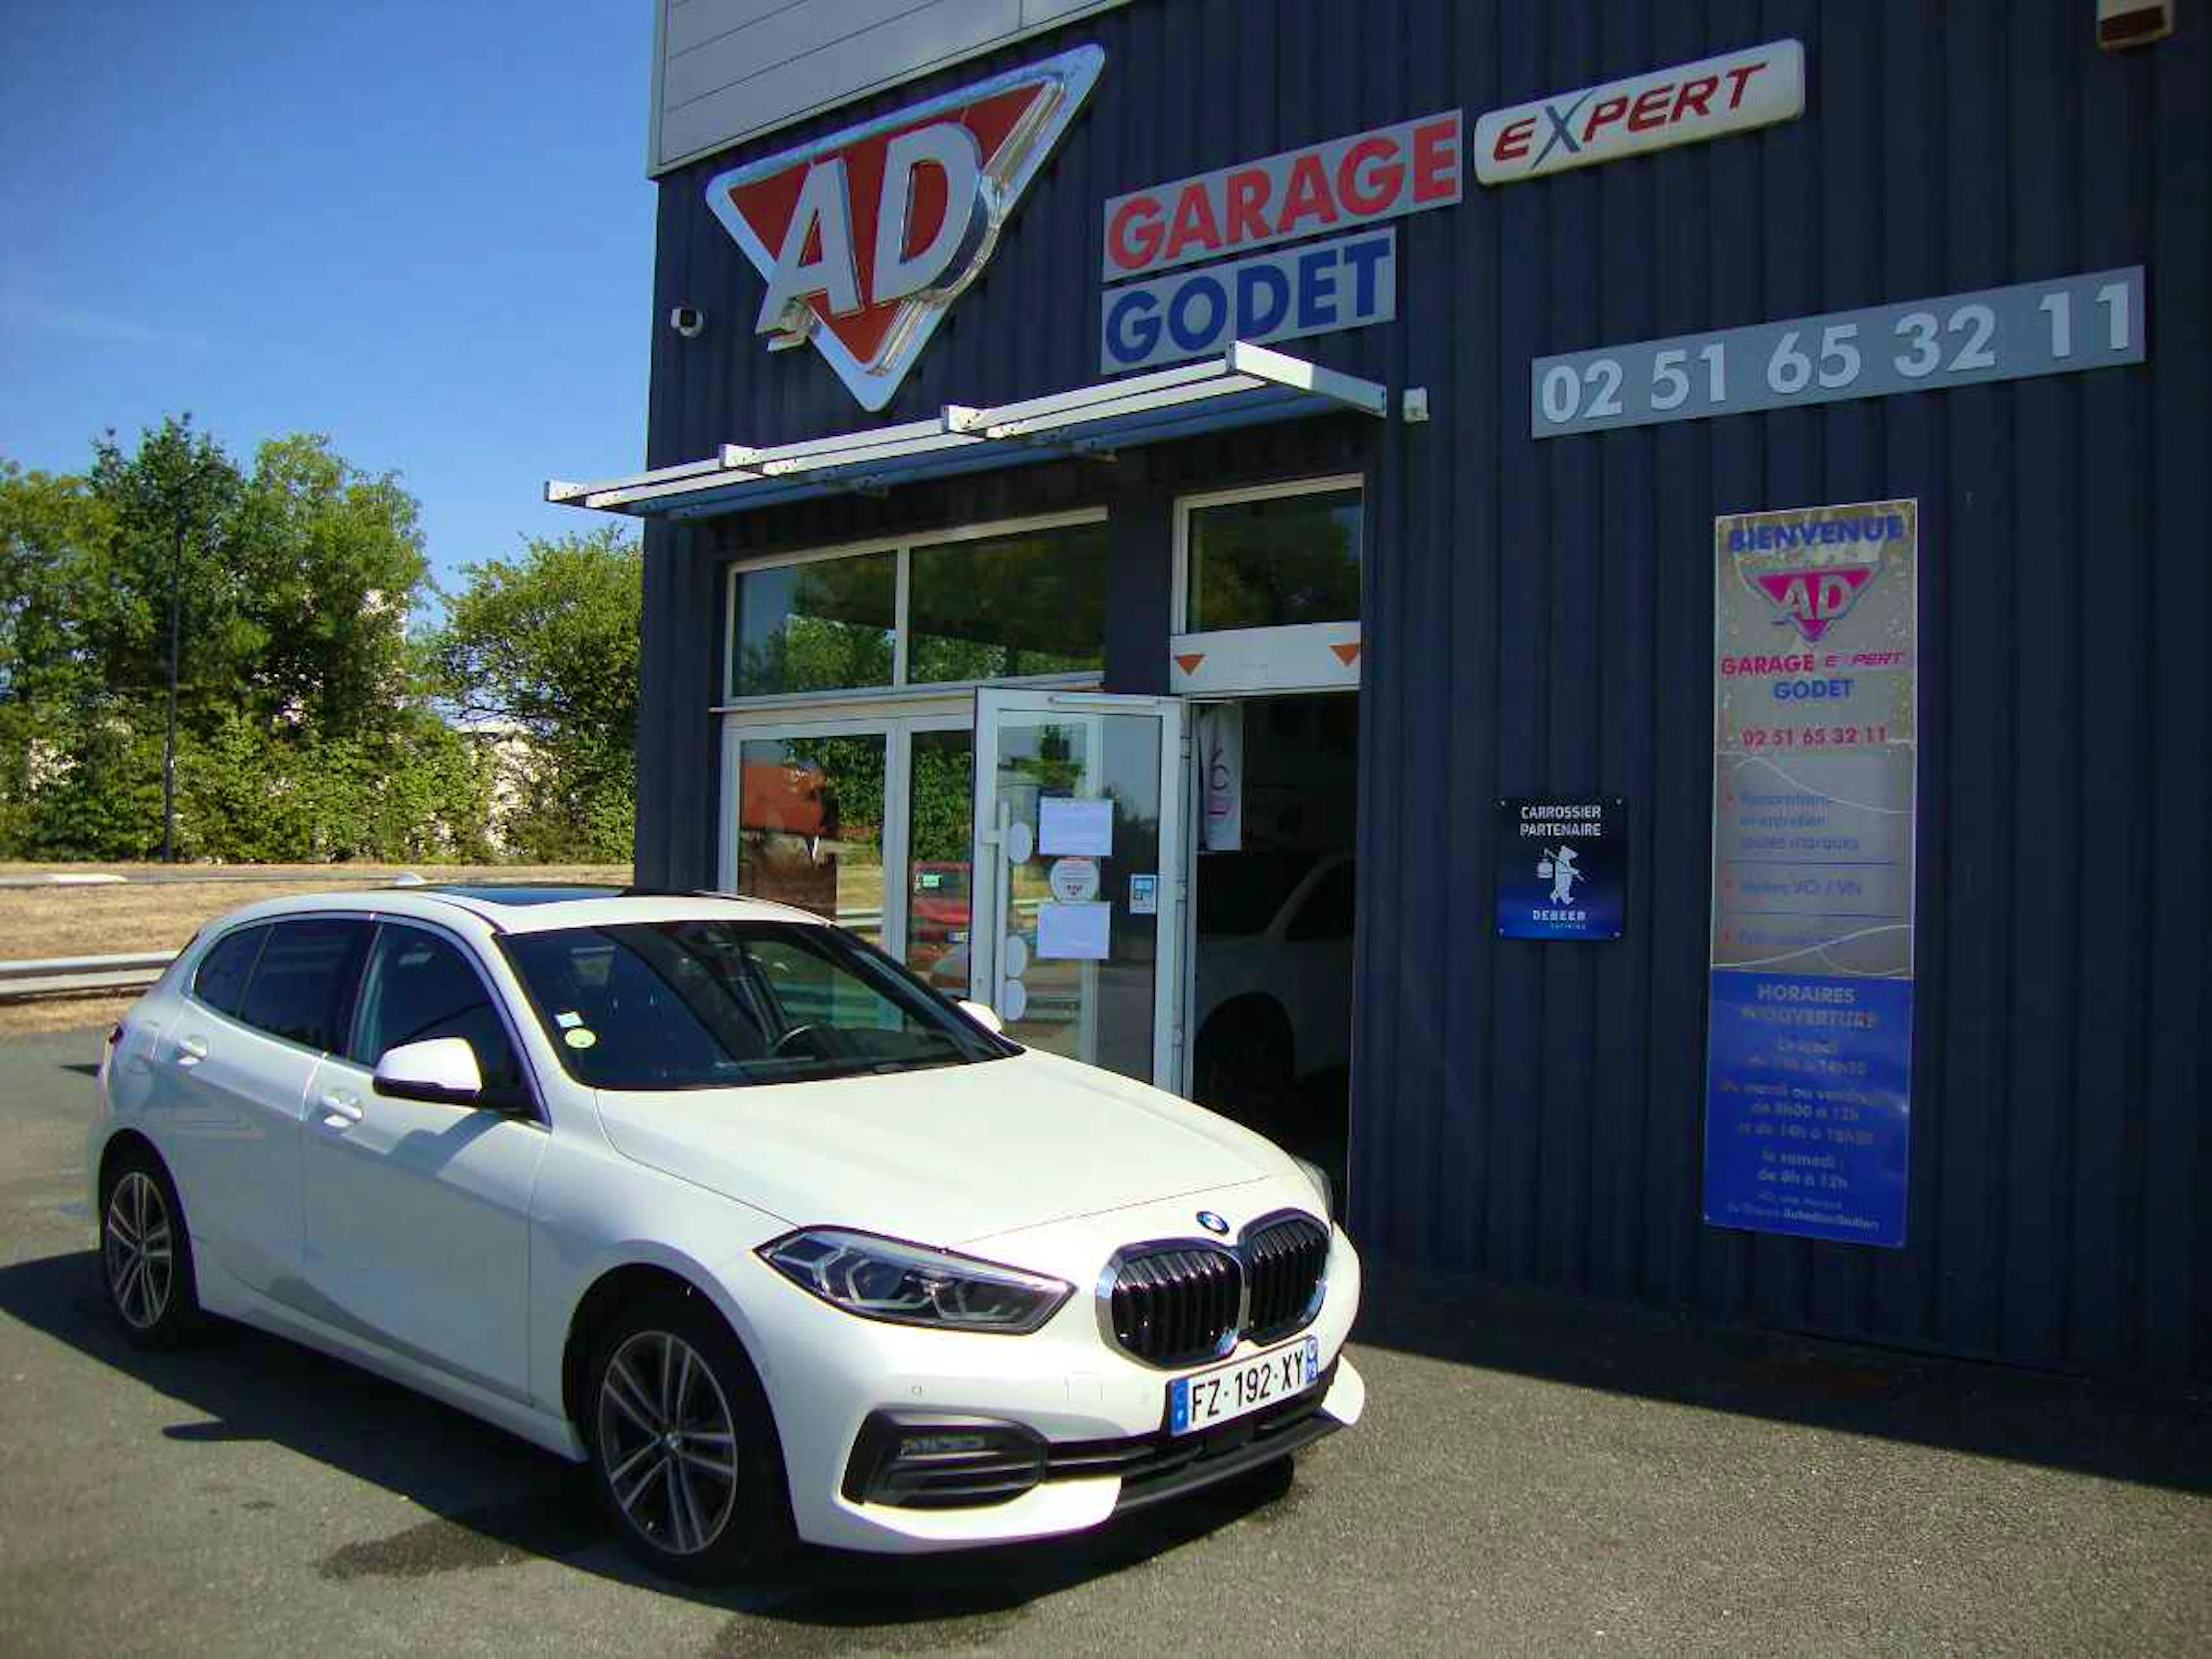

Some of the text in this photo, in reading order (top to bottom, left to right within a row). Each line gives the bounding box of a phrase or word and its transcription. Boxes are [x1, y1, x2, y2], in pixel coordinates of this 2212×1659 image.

[1493, 59, 1770, 171] EXPERT
[1107, 118, 1459, 271] GARAGE
[755, 118, 983, 338] AD
[1105, 237, 1390, 364] GODET
[1542, 281, 2130, 424] 02 51 65 32 11
[1729, 514, 1905, 552] BIENVENUE
[1773, 574, 1854, 623] AD
[1721, 650, 1906, 676] GARAGE EPERT
[1772, 679, 1855, 700] GODET
[1742, 726, 1888, 747] 02 51 65 32 11
[1520, 823, 1601, 836] PARTENAIRE
[1521, 805, 1601, 820] CARROSSIER
[1758, 983, 1856, 1003] HORAIRES
[1192, 1349, 1304, 1423] FZ-192-XY
